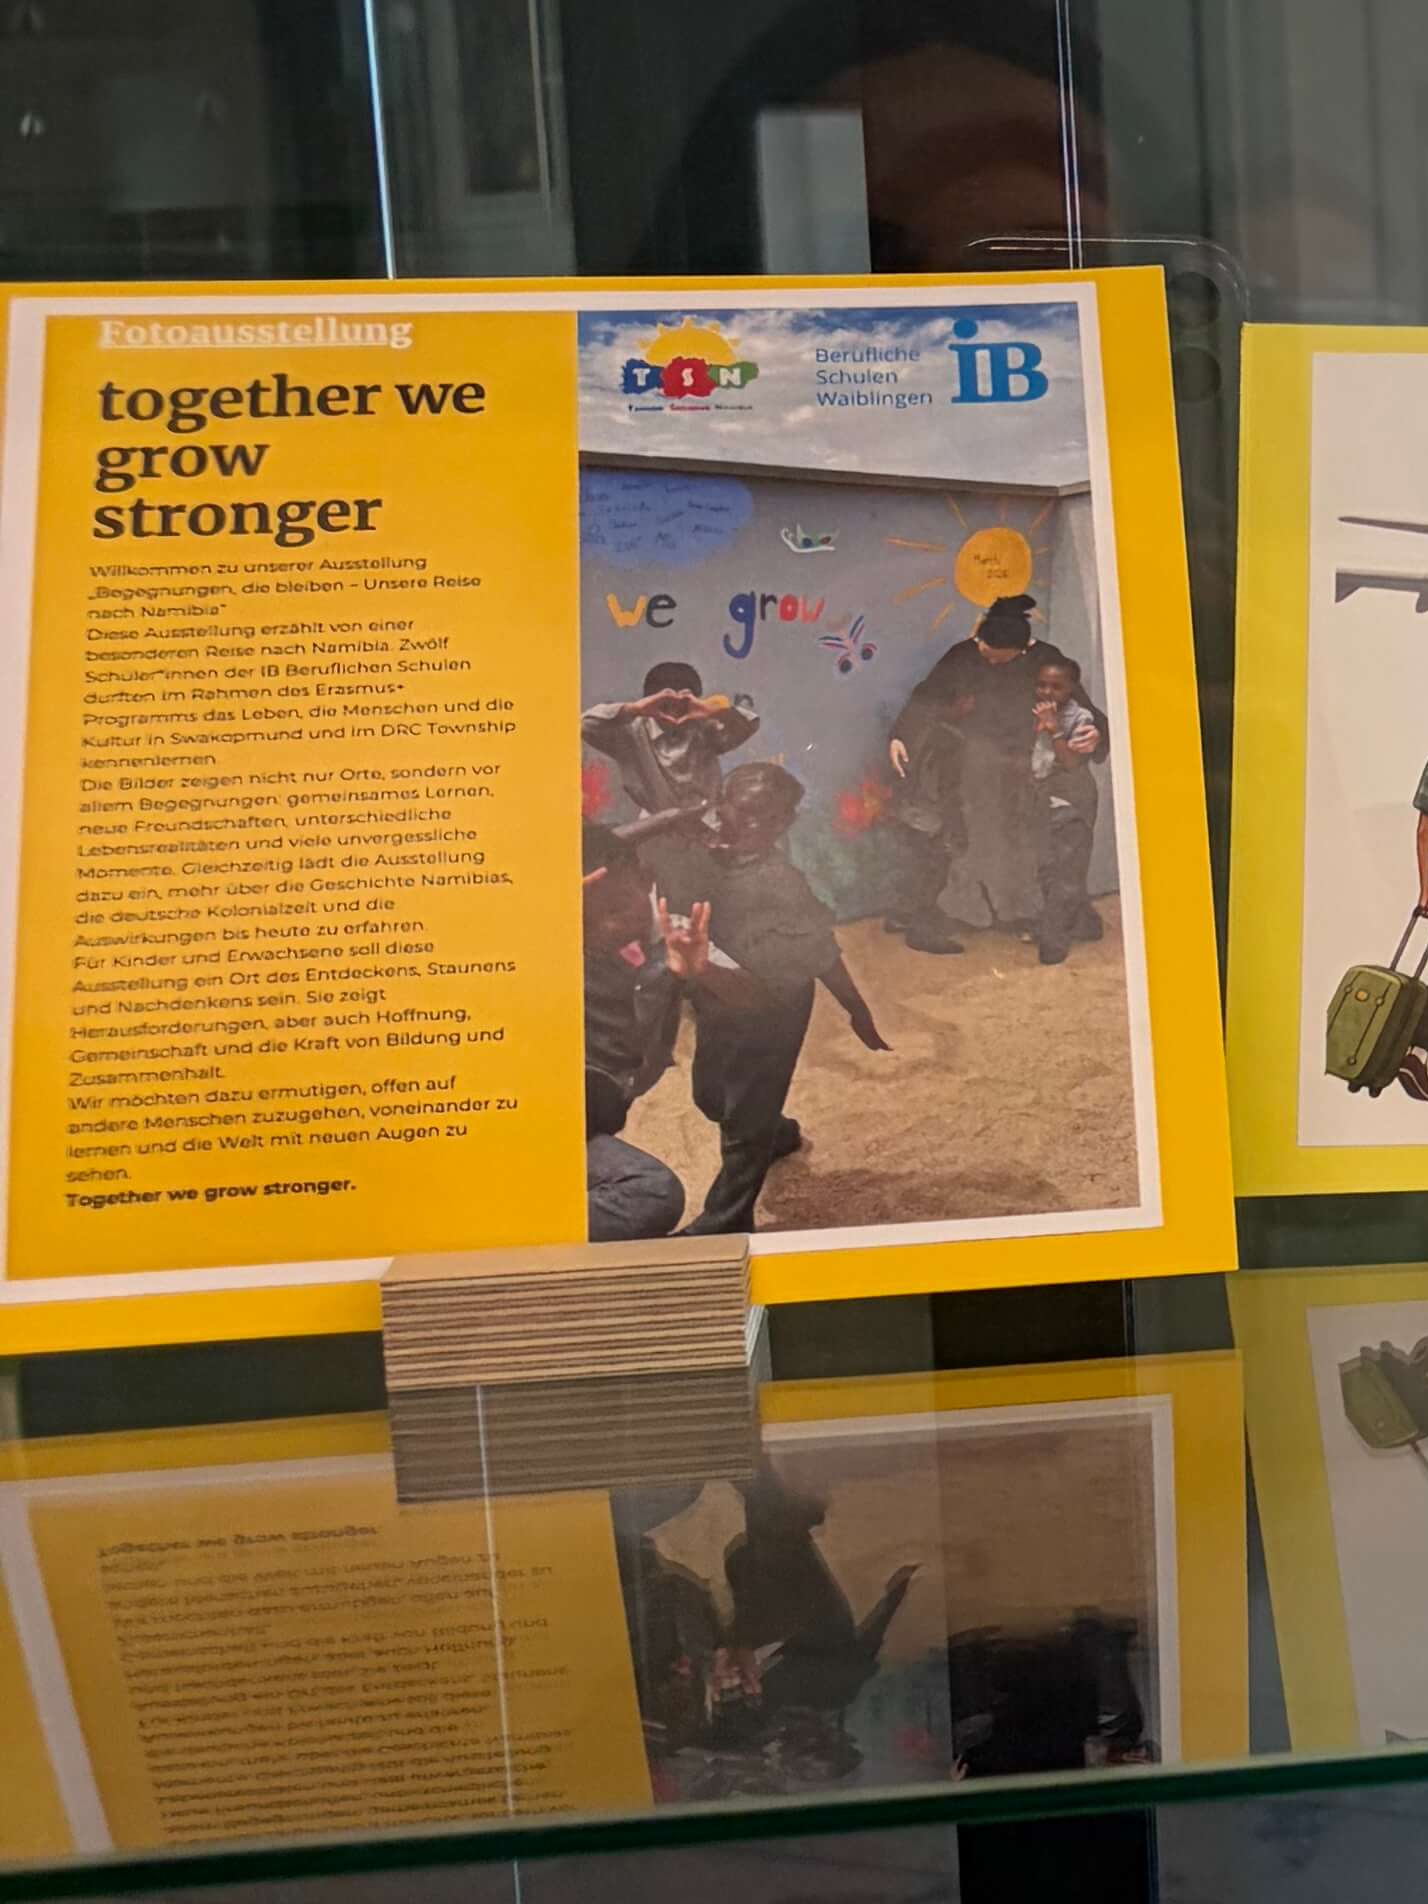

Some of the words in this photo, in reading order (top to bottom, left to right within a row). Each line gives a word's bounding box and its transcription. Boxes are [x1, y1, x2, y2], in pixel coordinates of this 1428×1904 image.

[100, 317, 413, 350] Fotoausstellung
[815, 347, 920, 364] Berufliche
[816, 368, 899, 386] Schulen
[99, 372, 382, 434] together
[394, 380, 486, 416] we
[816, 389, 933, 411] Waiblingen
[93, 442, 271, 494] grow
[92, 497, 383, 548] stronger
[606, 593, 677, 629] we
[722, 590, 825, 660] grow
